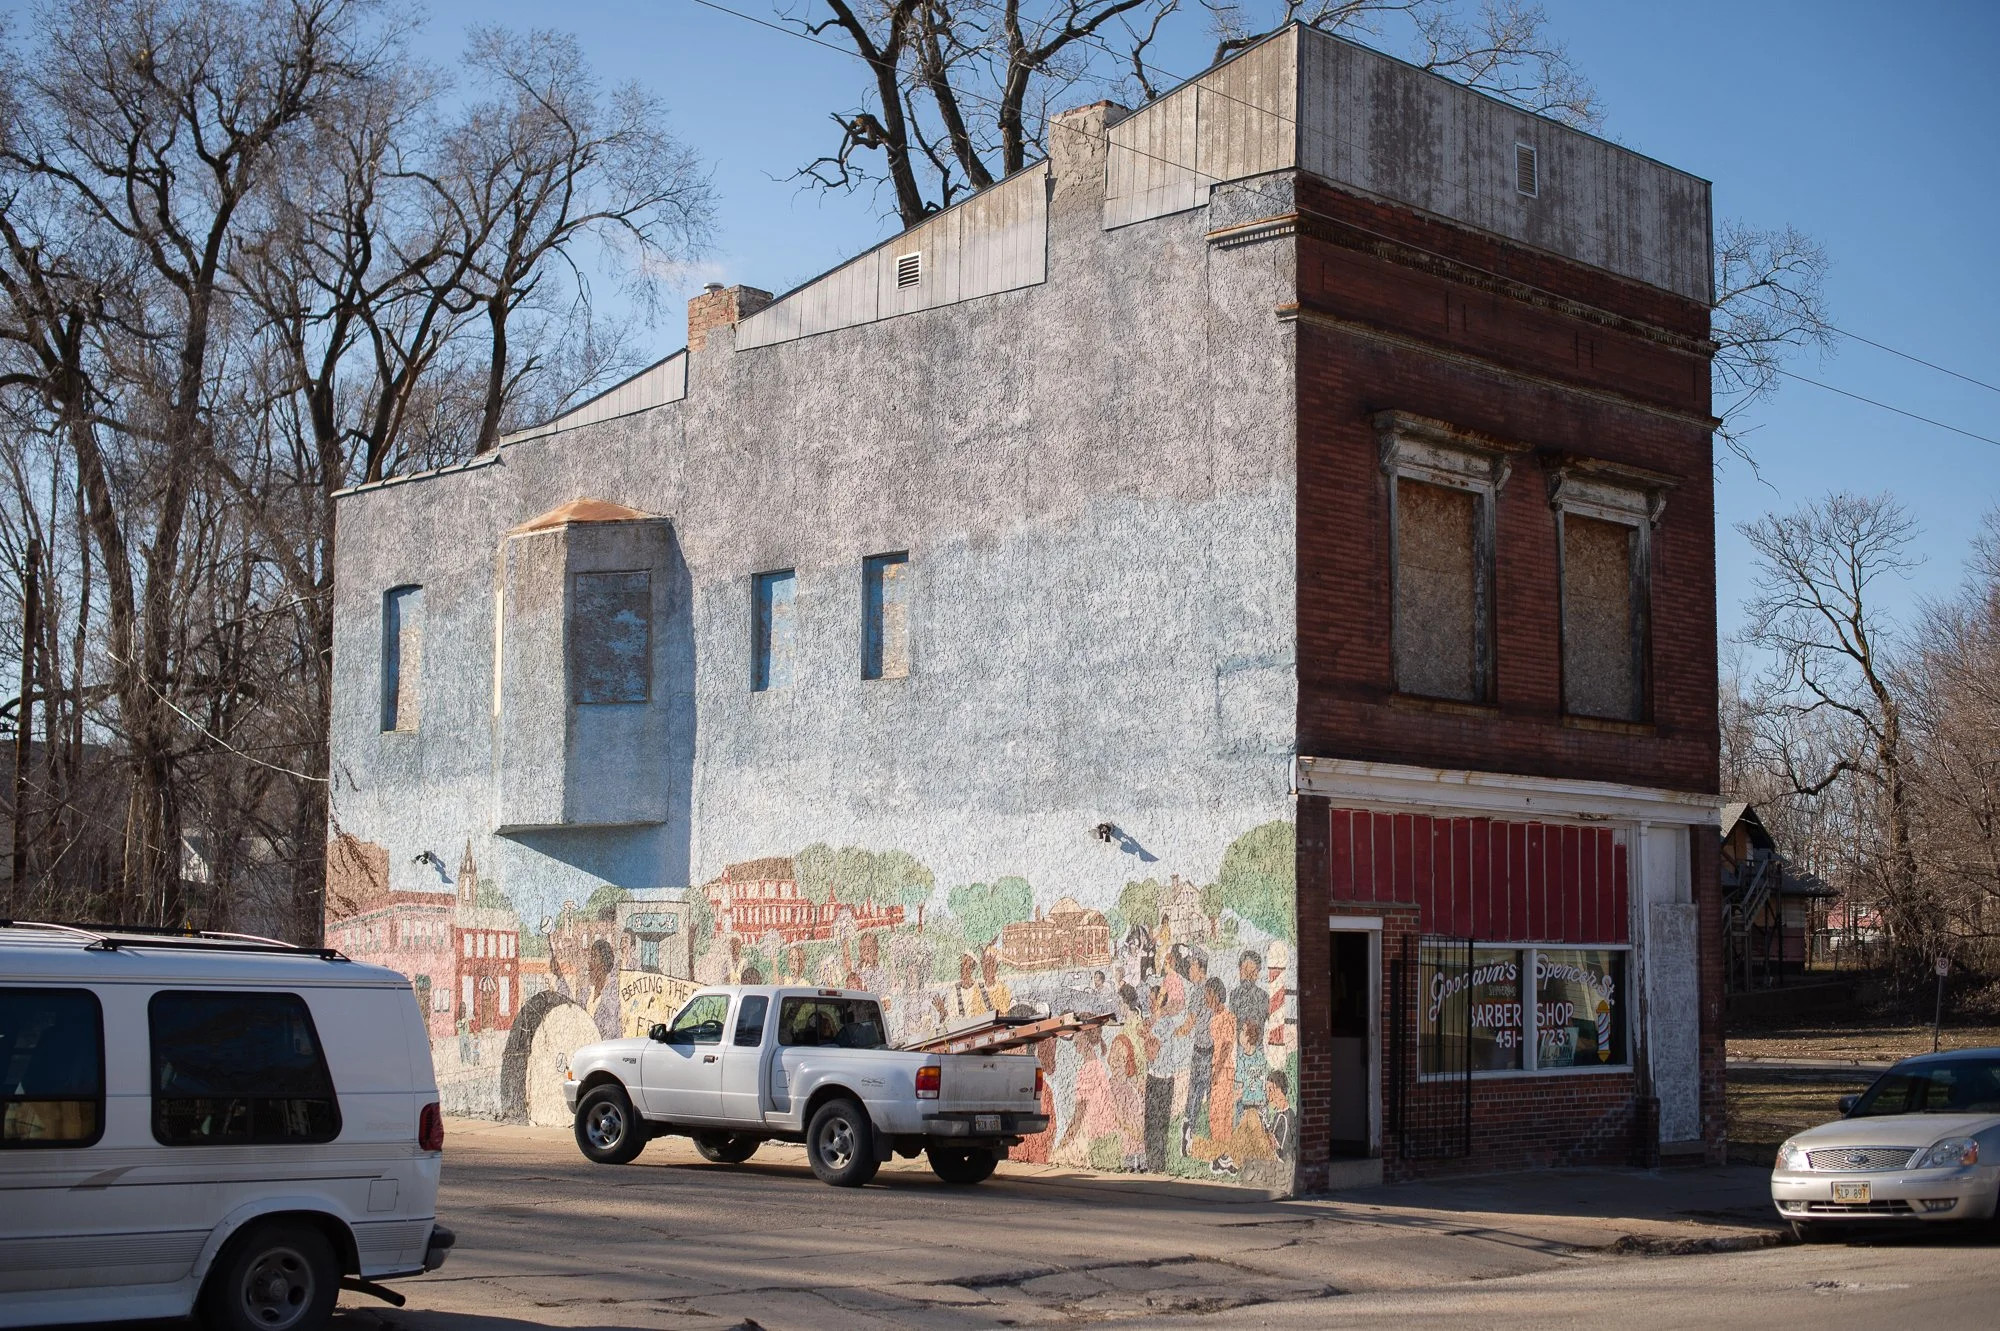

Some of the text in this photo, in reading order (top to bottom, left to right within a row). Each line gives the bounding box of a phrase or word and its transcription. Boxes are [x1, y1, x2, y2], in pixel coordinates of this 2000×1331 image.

[621, 976, 663, 1002] BEATING
[666, 979, 689, 1003] THE
[1536, 1002, 1574, 1027] SHOP
[1495, 1029, 1565, 1049] 451-723
